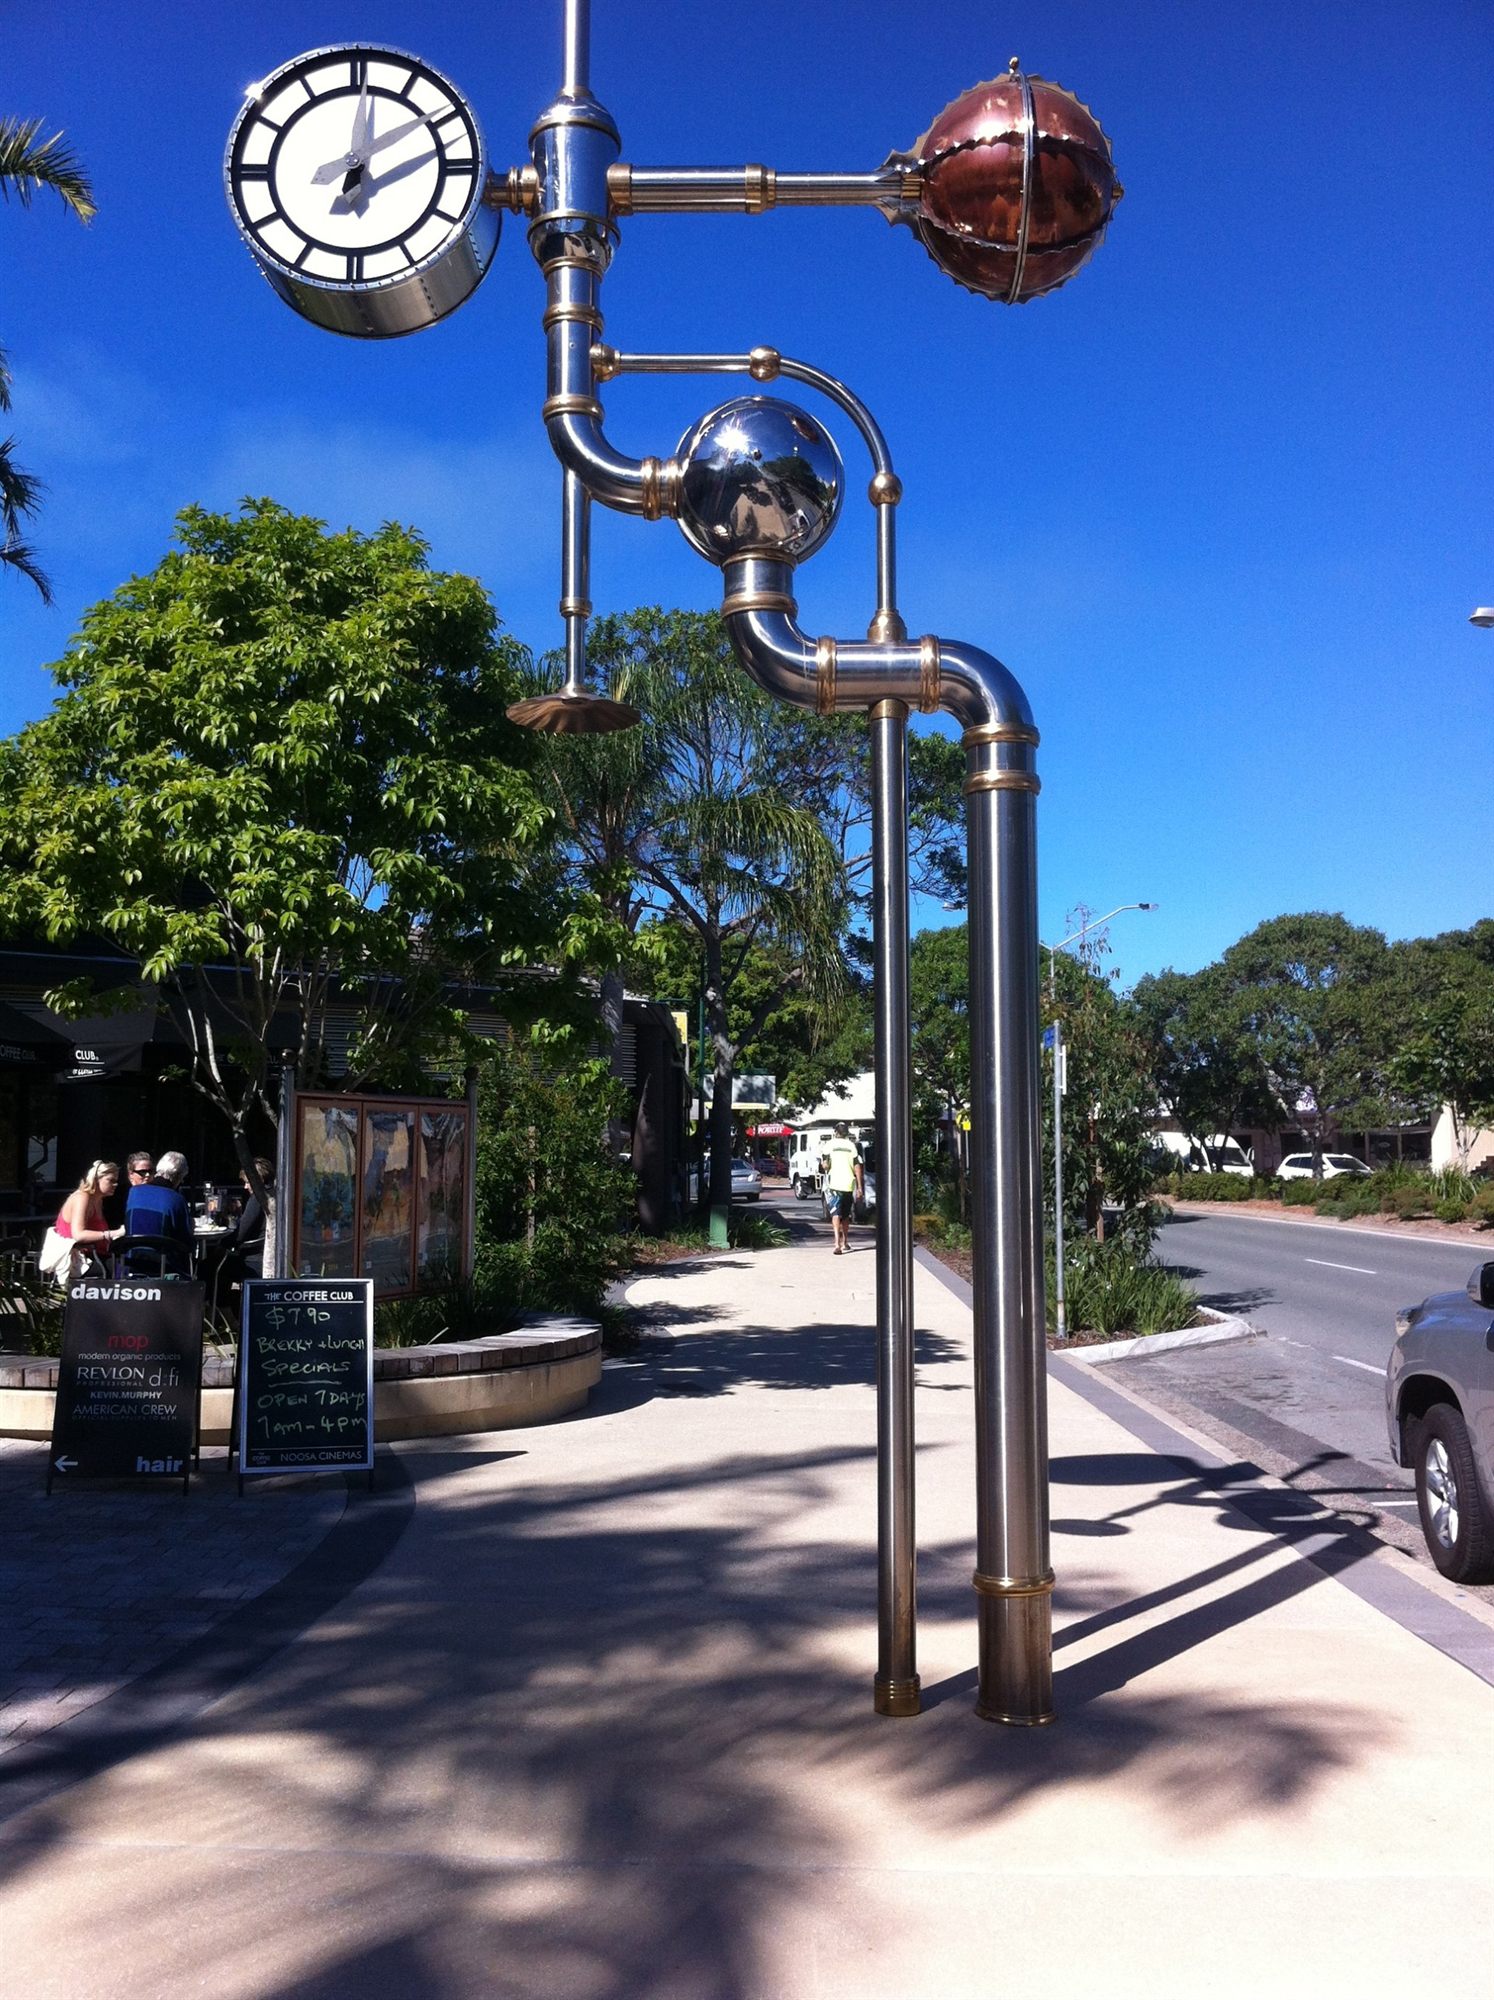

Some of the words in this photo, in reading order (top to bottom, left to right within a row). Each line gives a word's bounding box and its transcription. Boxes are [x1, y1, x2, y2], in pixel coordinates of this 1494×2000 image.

[75, 1049, 96, 1061] CLUB
[71, 1284, 162, 1301] davison
[284, 1291, 328, 1302] COFFEE
[330, 1291, 354, 1301] CLUB
[108, 1334, 149, 1351] mop
[78, 1353, 110, 1361] modern
[112, 1353, 143, 1362] organic
[144, 1353, 181, 1362] products
[77, 1367, 145, 1379] REVLON
[257, 1393, 308, 1409] OPEN
[73, 1404, 137, 1415] AMERICAN
[141, 1404, 177, 1415] CREW
[280, 1453, 317, 1462] NOOSA
[318, 1451, 362, 1461] CINEMAS
[136, 1456, 184, 1473] hair
